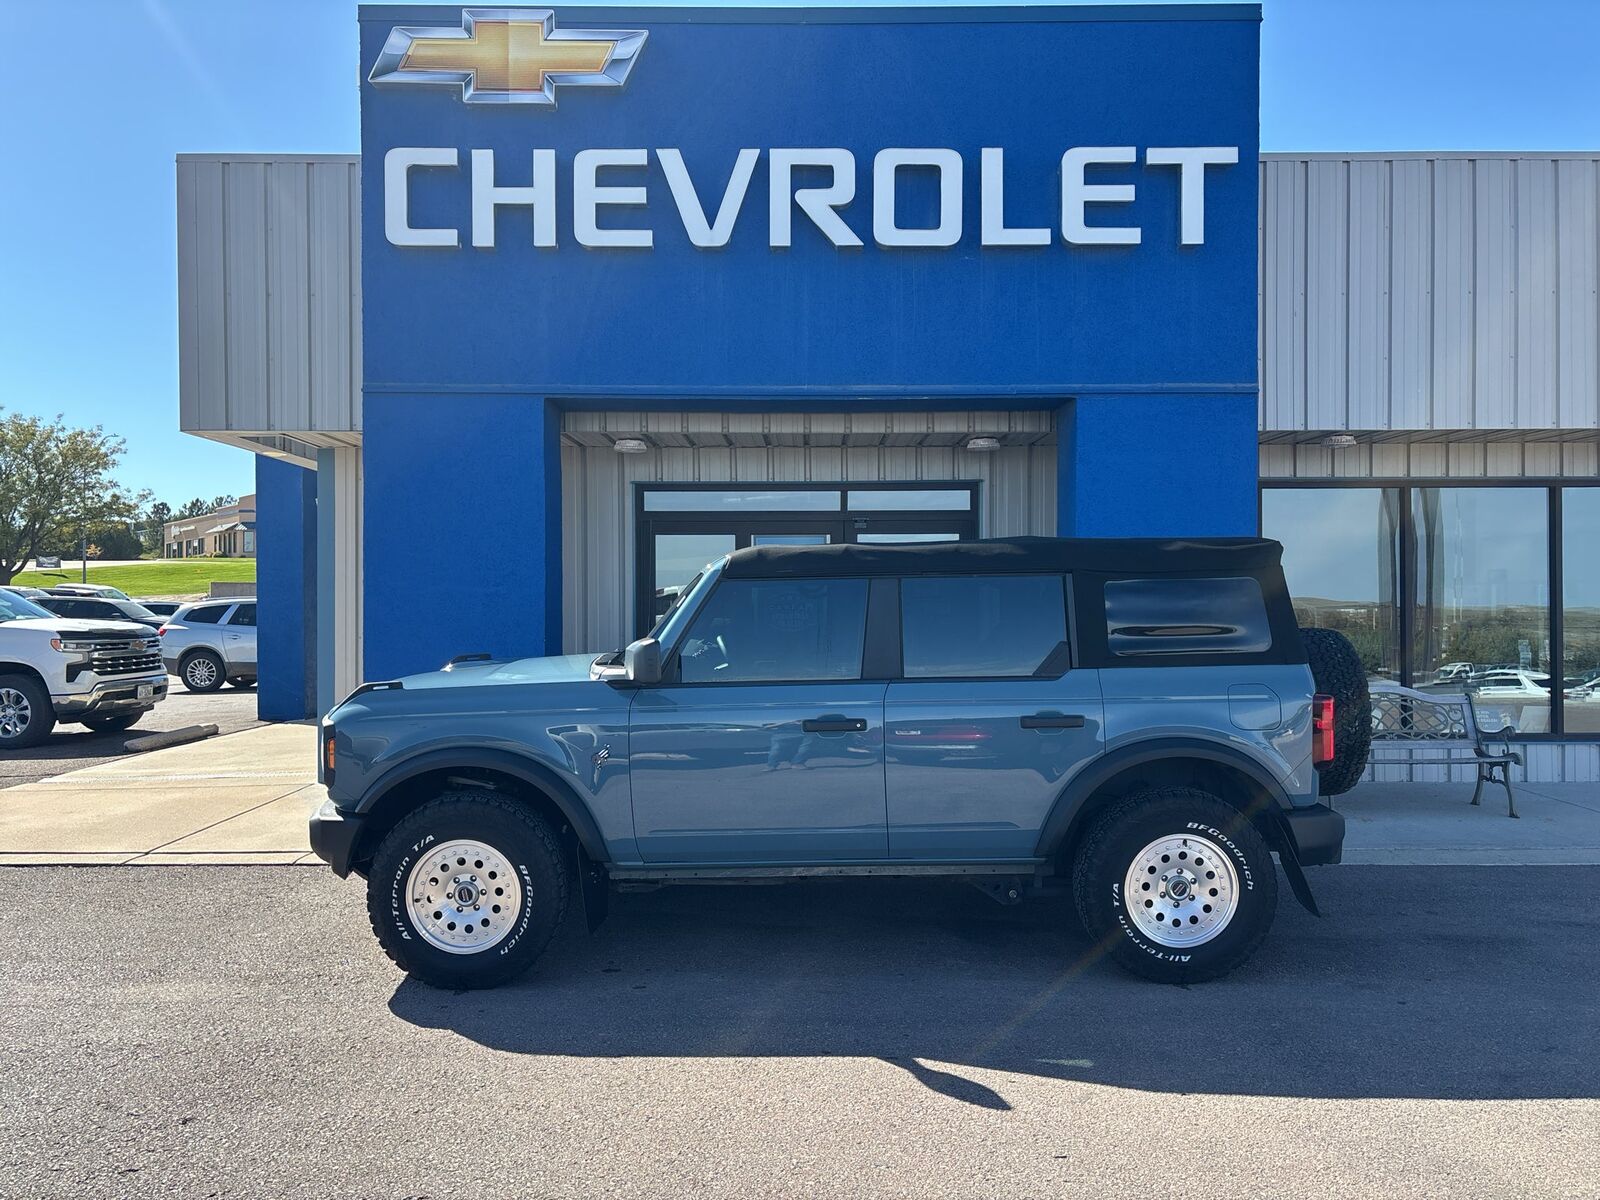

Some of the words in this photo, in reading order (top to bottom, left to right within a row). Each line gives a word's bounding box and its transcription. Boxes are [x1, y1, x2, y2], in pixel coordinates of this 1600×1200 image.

[383, 145, 1240, 248] CHEVROLET
[390, 856, 412, 940] All-Terrain
[411, 834, 435, 852] T/A
[1111, 883, 1120, 908] T/A
[1186, 821, 1254, 891] BFGoodrich
[500, 864, 534, 956] BFGoodrich
[1117, 915, 1192, 963] All-Terrain
